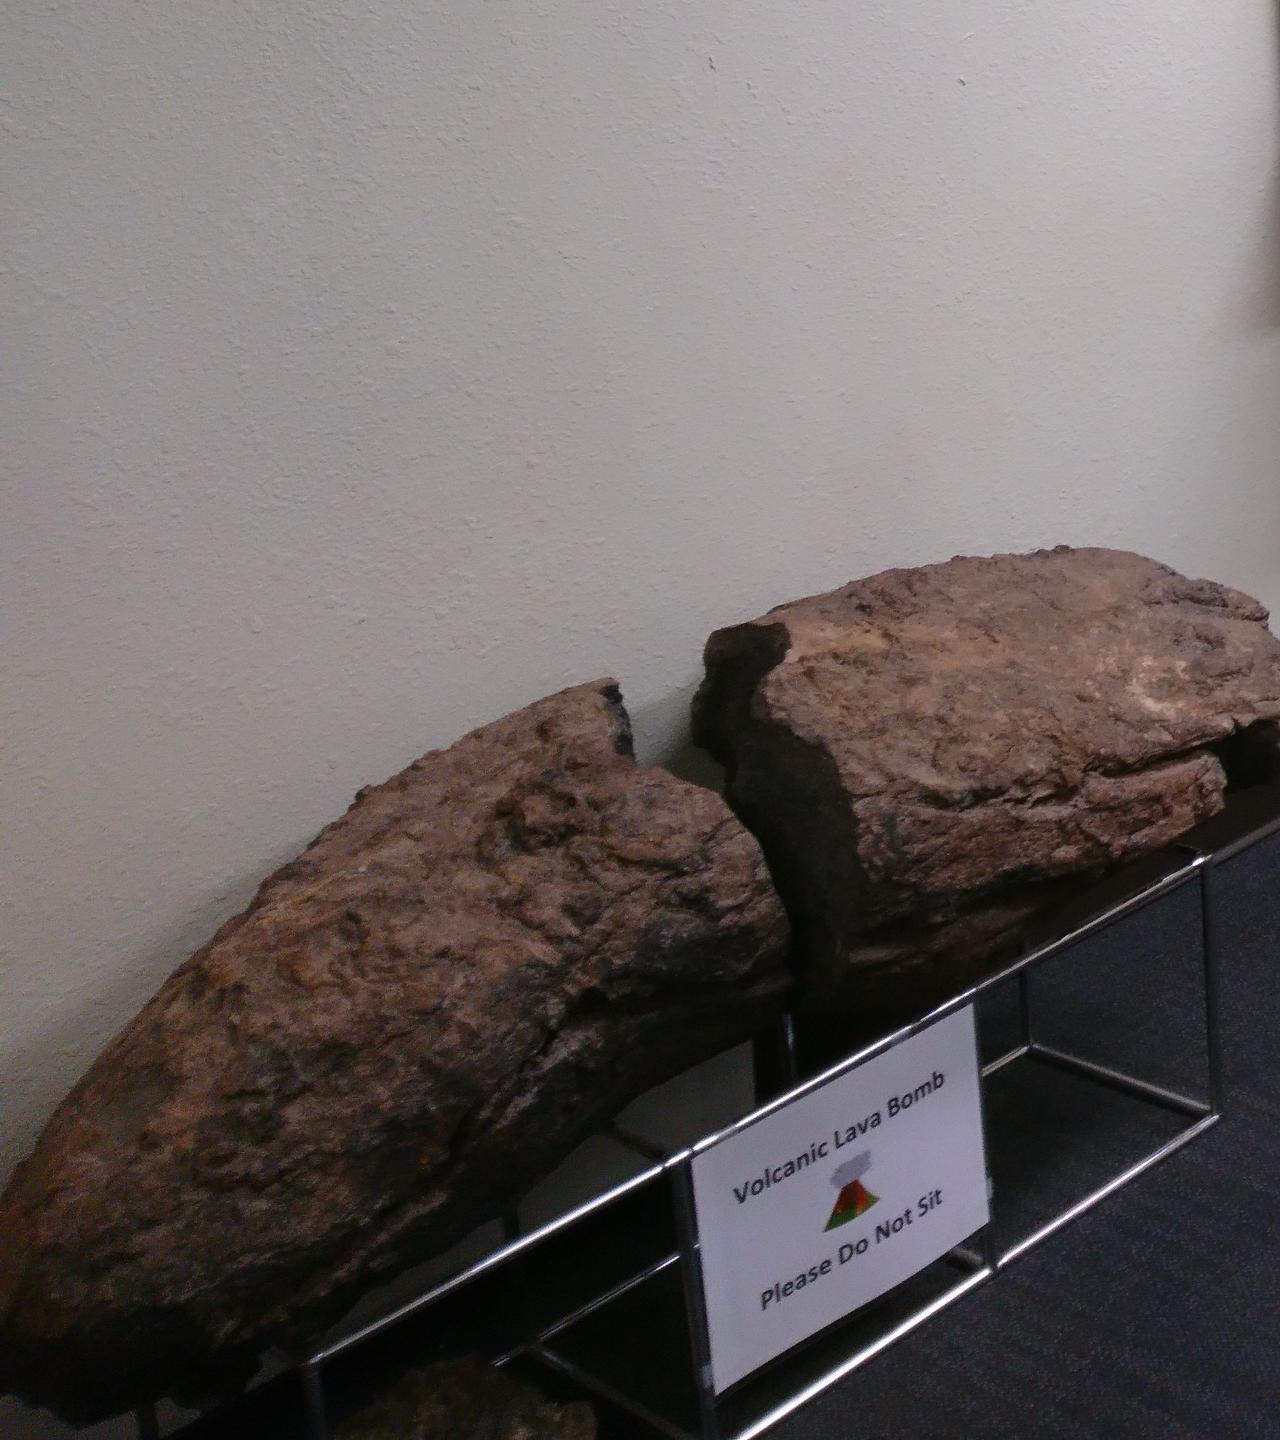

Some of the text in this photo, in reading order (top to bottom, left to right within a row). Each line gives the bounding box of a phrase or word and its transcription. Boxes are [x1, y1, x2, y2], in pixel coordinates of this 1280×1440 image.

[732, 1070, 946, 1205] Volcanic Lava Bomb
[760, 1188, 944, 1311] Please Do Not Sit
